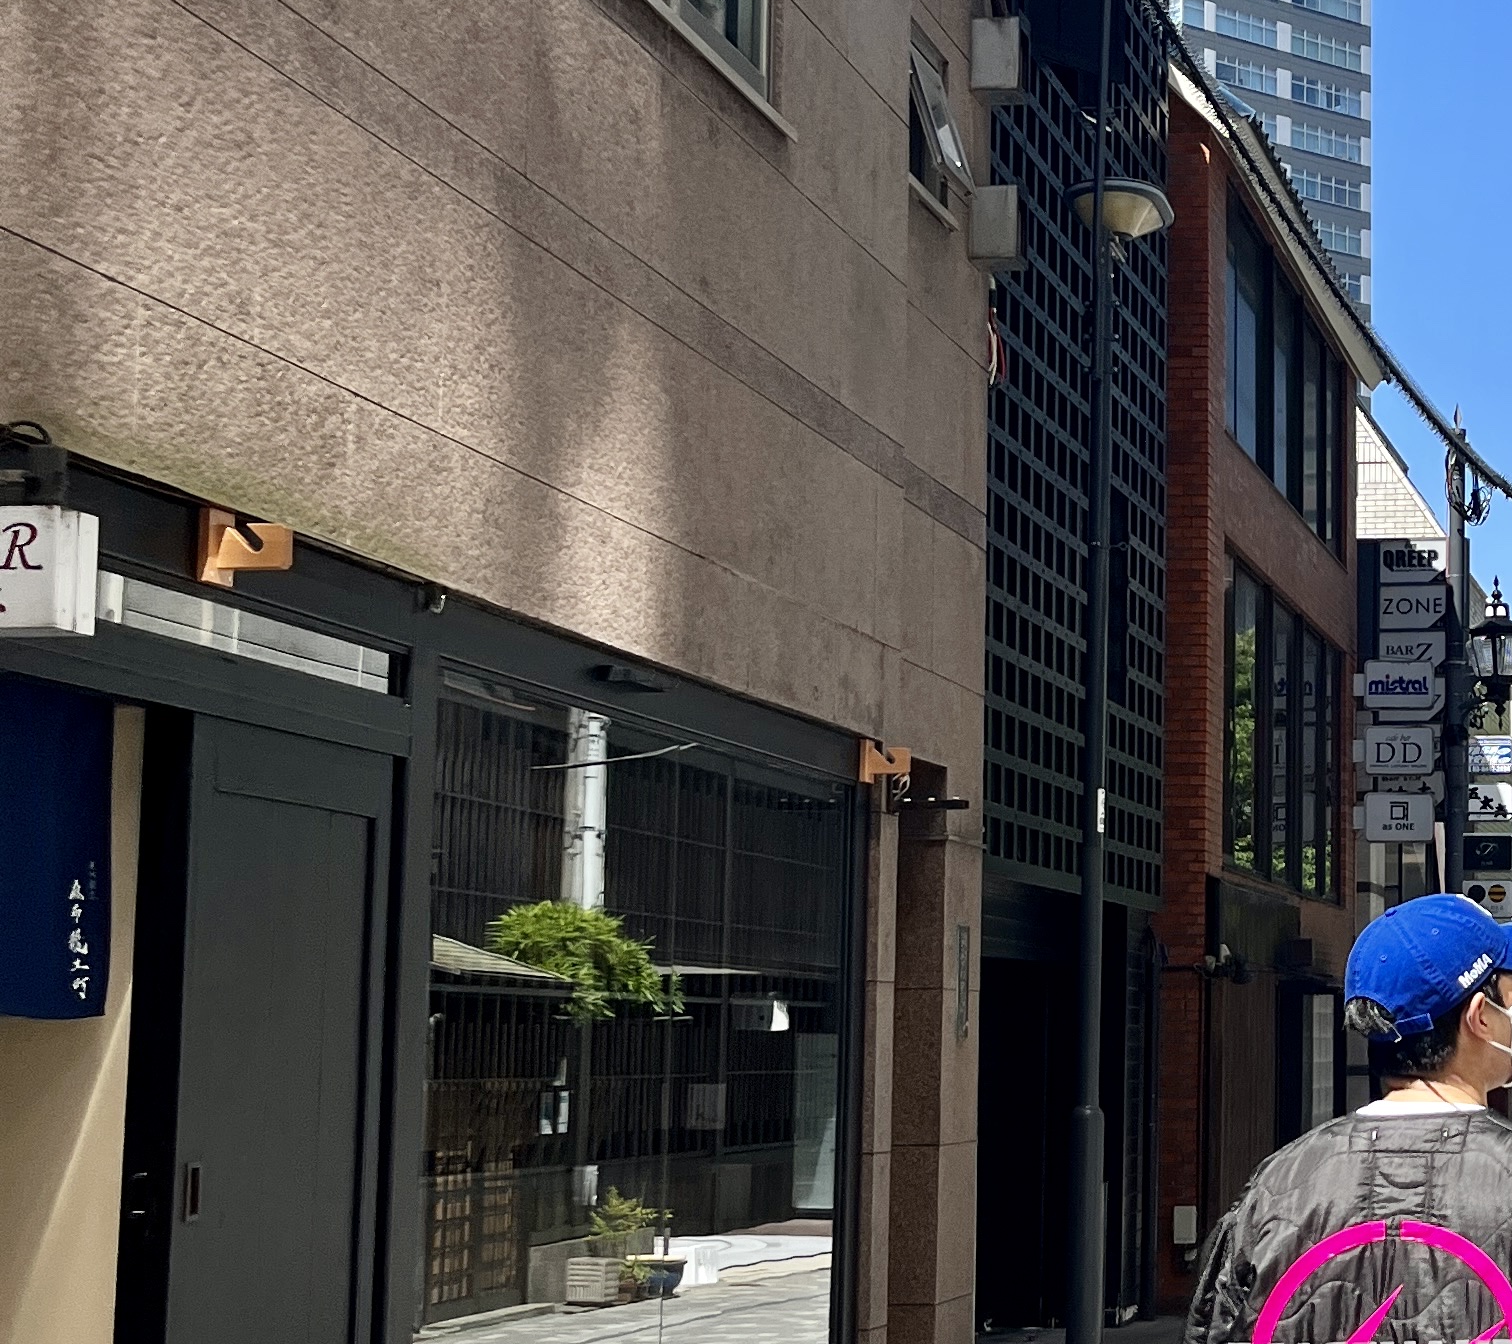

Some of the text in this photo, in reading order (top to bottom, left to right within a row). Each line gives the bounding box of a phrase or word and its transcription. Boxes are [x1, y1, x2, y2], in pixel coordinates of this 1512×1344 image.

[1382, 549, 1439, 571] QREEP
[1382, 597, 1443, 614] ZONE
[1386, 642, 1433, 660] BAR Z
[1368, 674, 1429, 694] mistral
[1382, 822, 1415, 831] as ONE
[1458, 953, 1493, 989] MoMA
